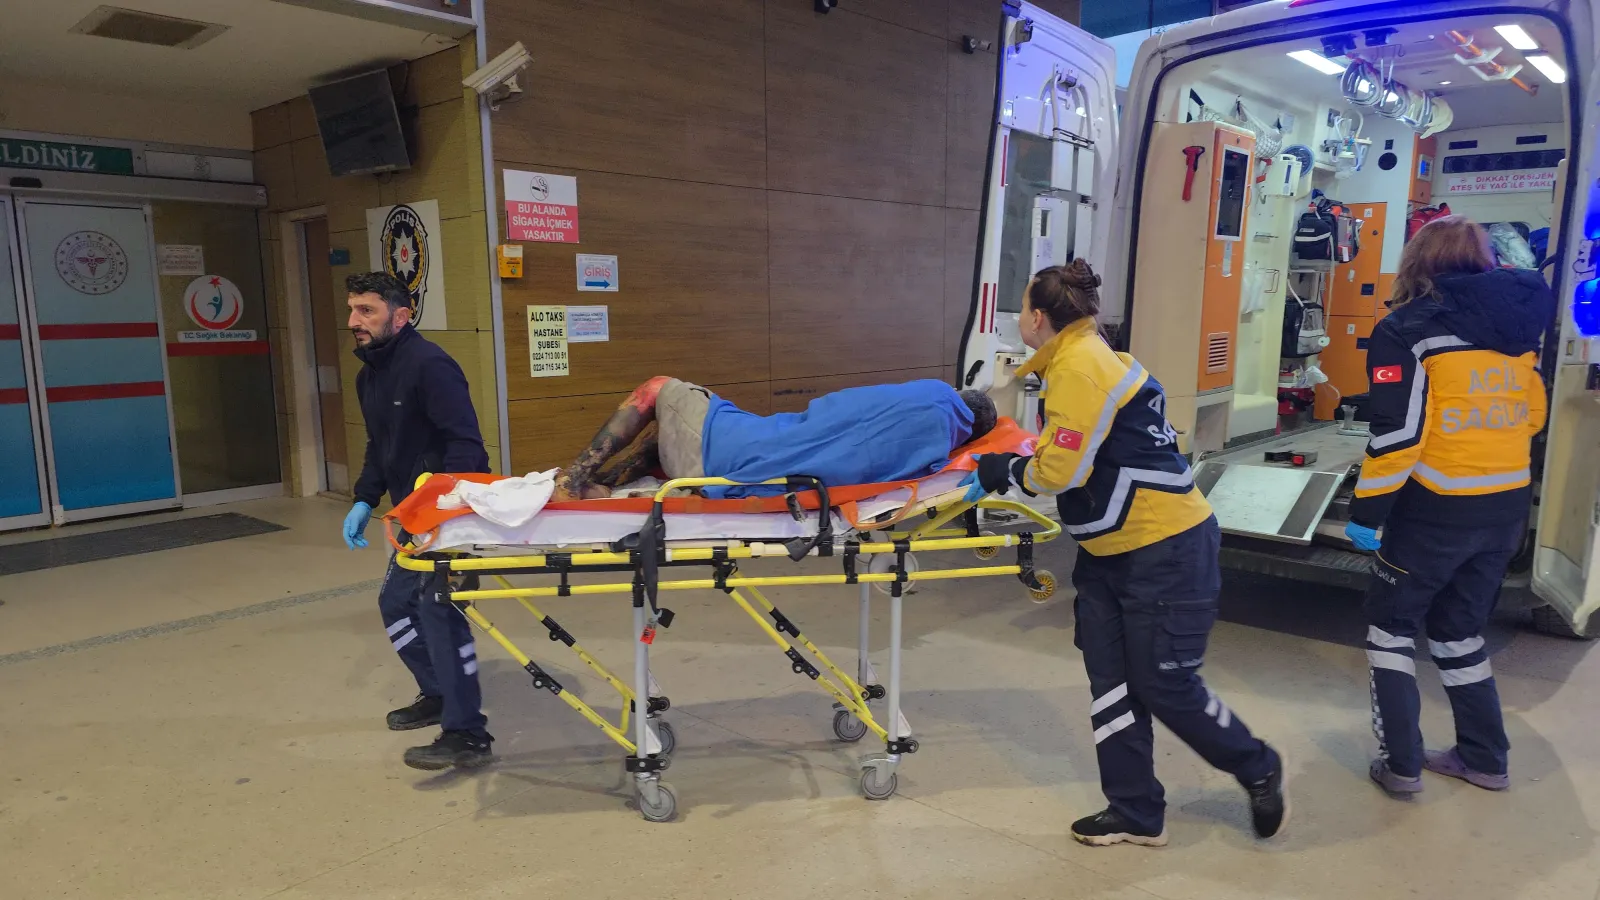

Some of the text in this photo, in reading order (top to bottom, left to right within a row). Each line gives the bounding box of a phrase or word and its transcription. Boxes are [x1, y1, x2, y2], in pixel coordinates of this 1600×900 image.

[0, 143, 96, 169] LDİNİZ
[518, 203, 567, 216] BU ALANDA
[390, 211, 415, 230] POLİS
[512, 215, 573, 230] SİGARA İÇMEK
[523, 229, 565, 241] YASAKTIR
[530, 311, 544, 322] ALO
[533, 328, 563, 337] HASTANE
